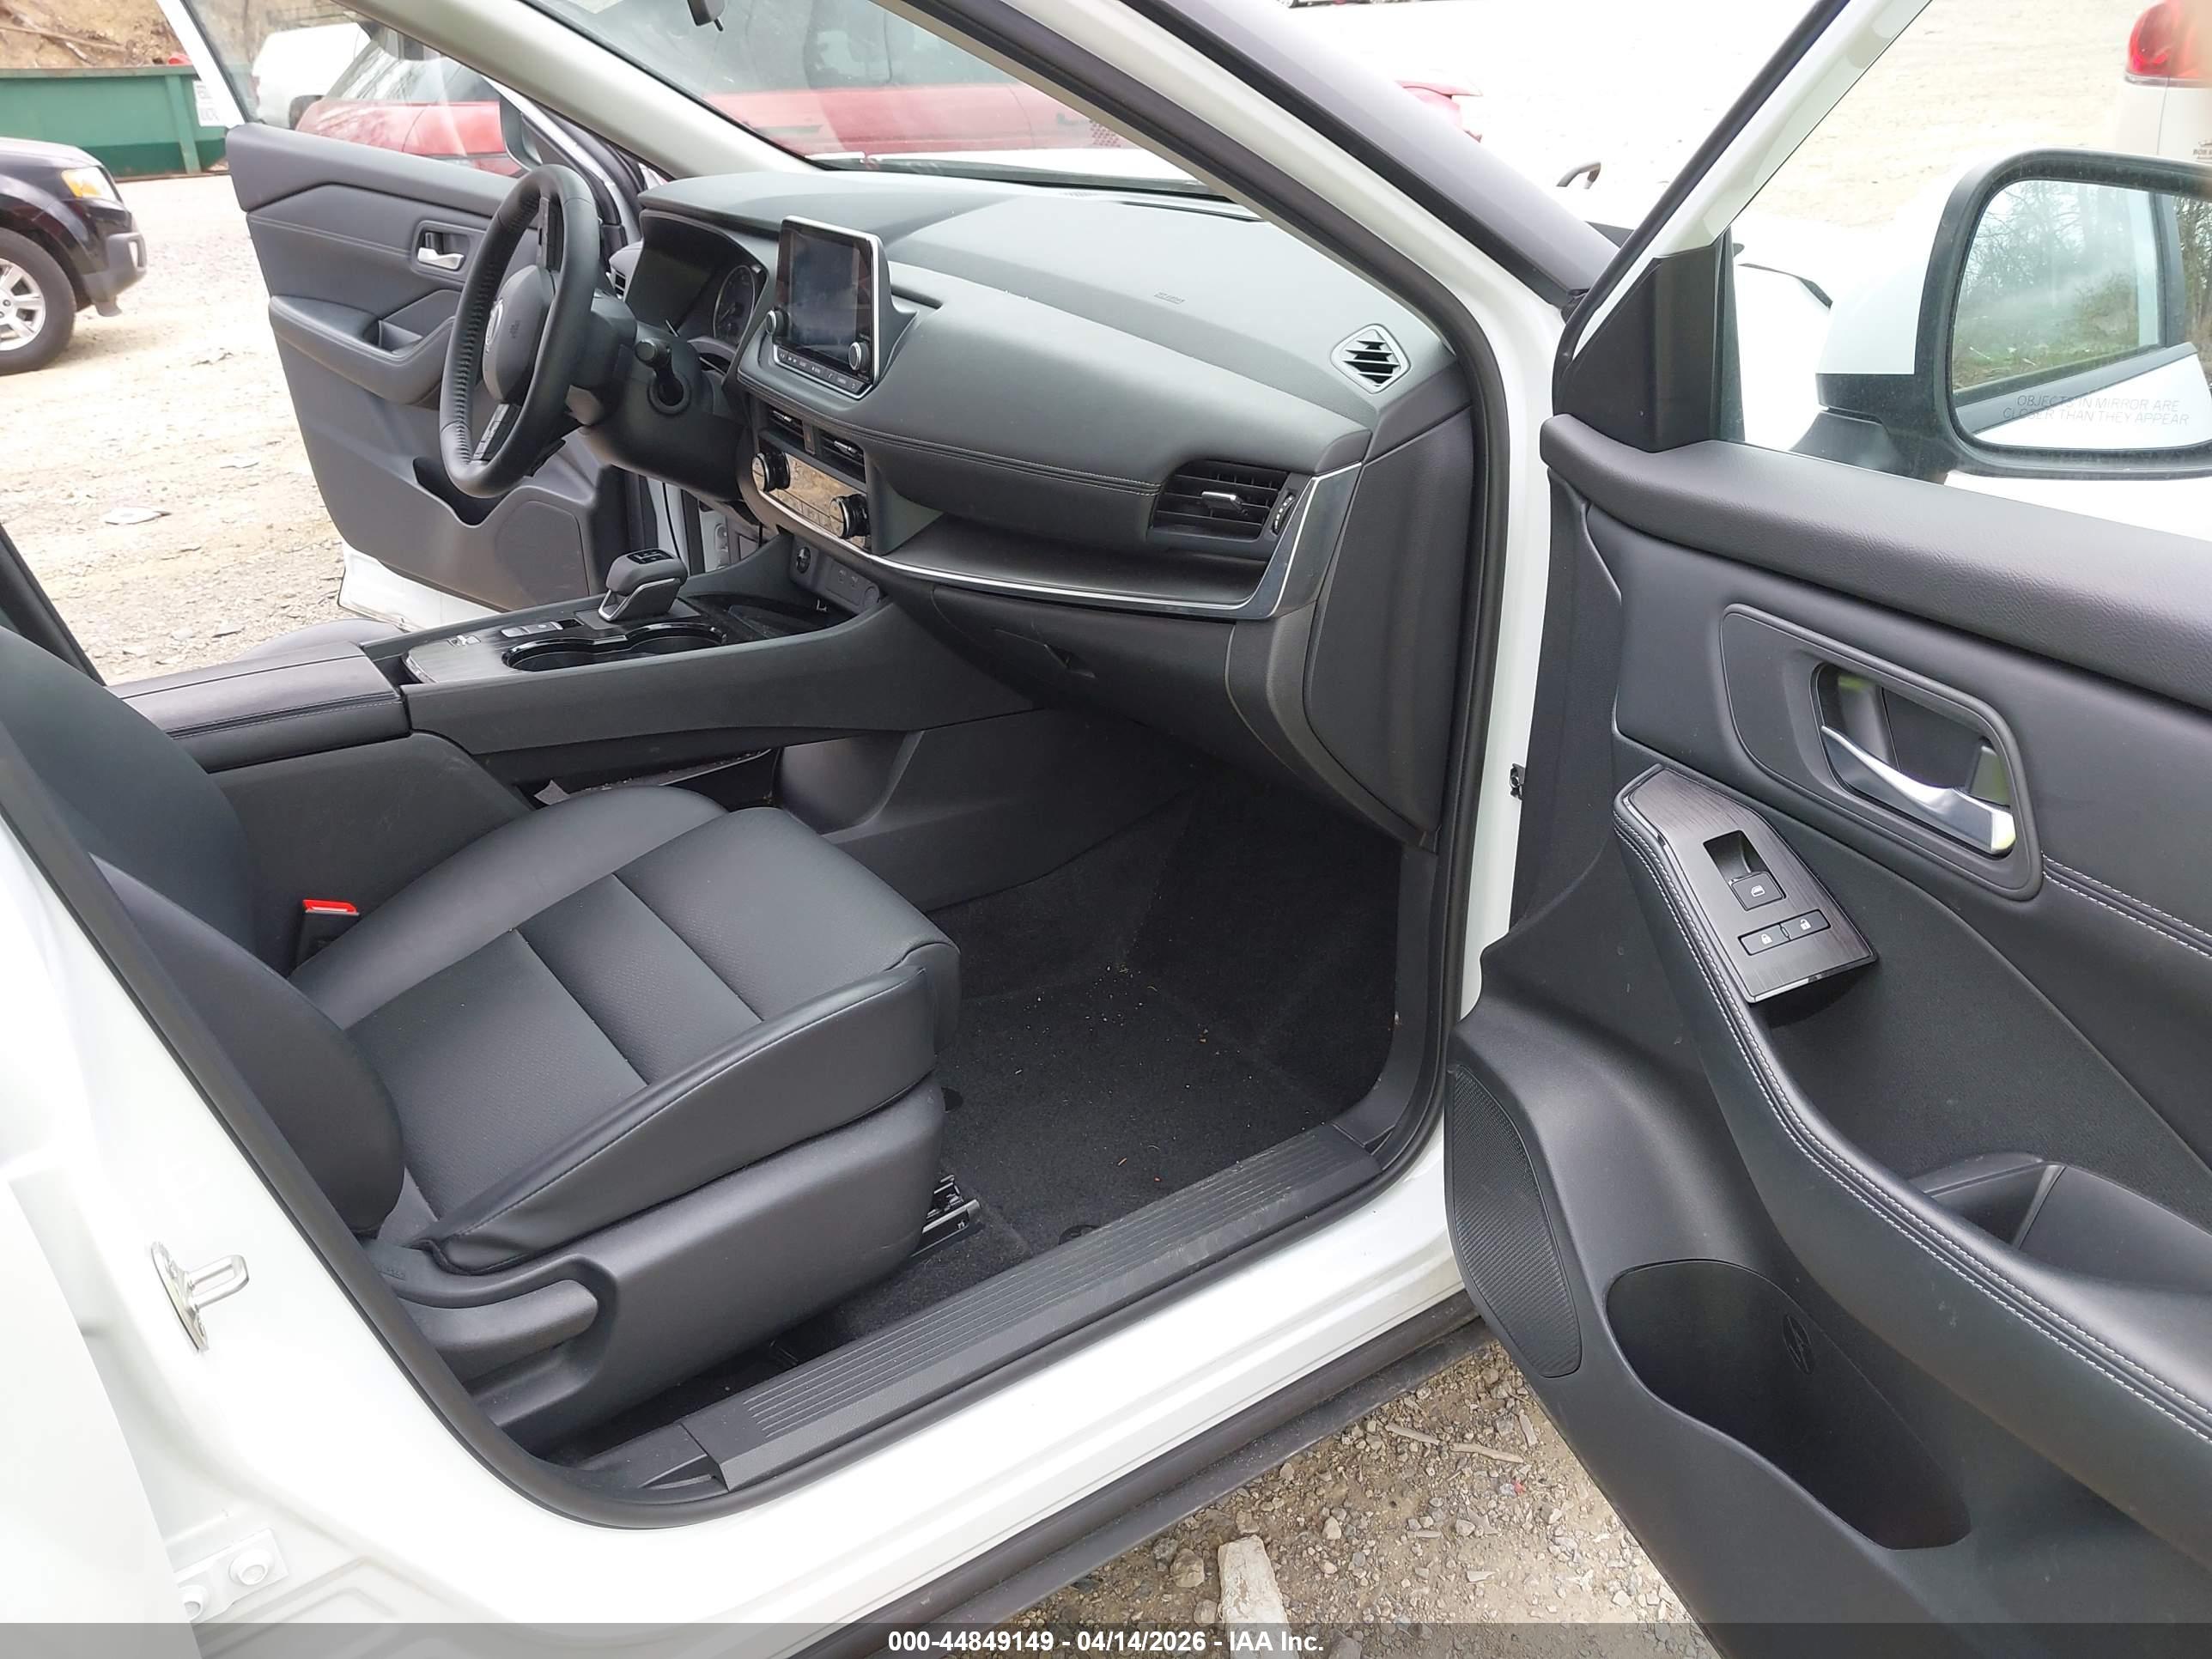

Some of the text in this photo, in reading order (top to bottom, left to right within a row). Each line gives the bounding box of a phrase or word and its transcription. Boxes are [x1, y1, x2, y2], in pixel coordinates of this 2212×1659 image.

[2017, 395, 2180, 412] OBJECTS IN MIRROR ARE
[2002, 407, 2190, 426] CLOSER THAN THEY APPEAR
